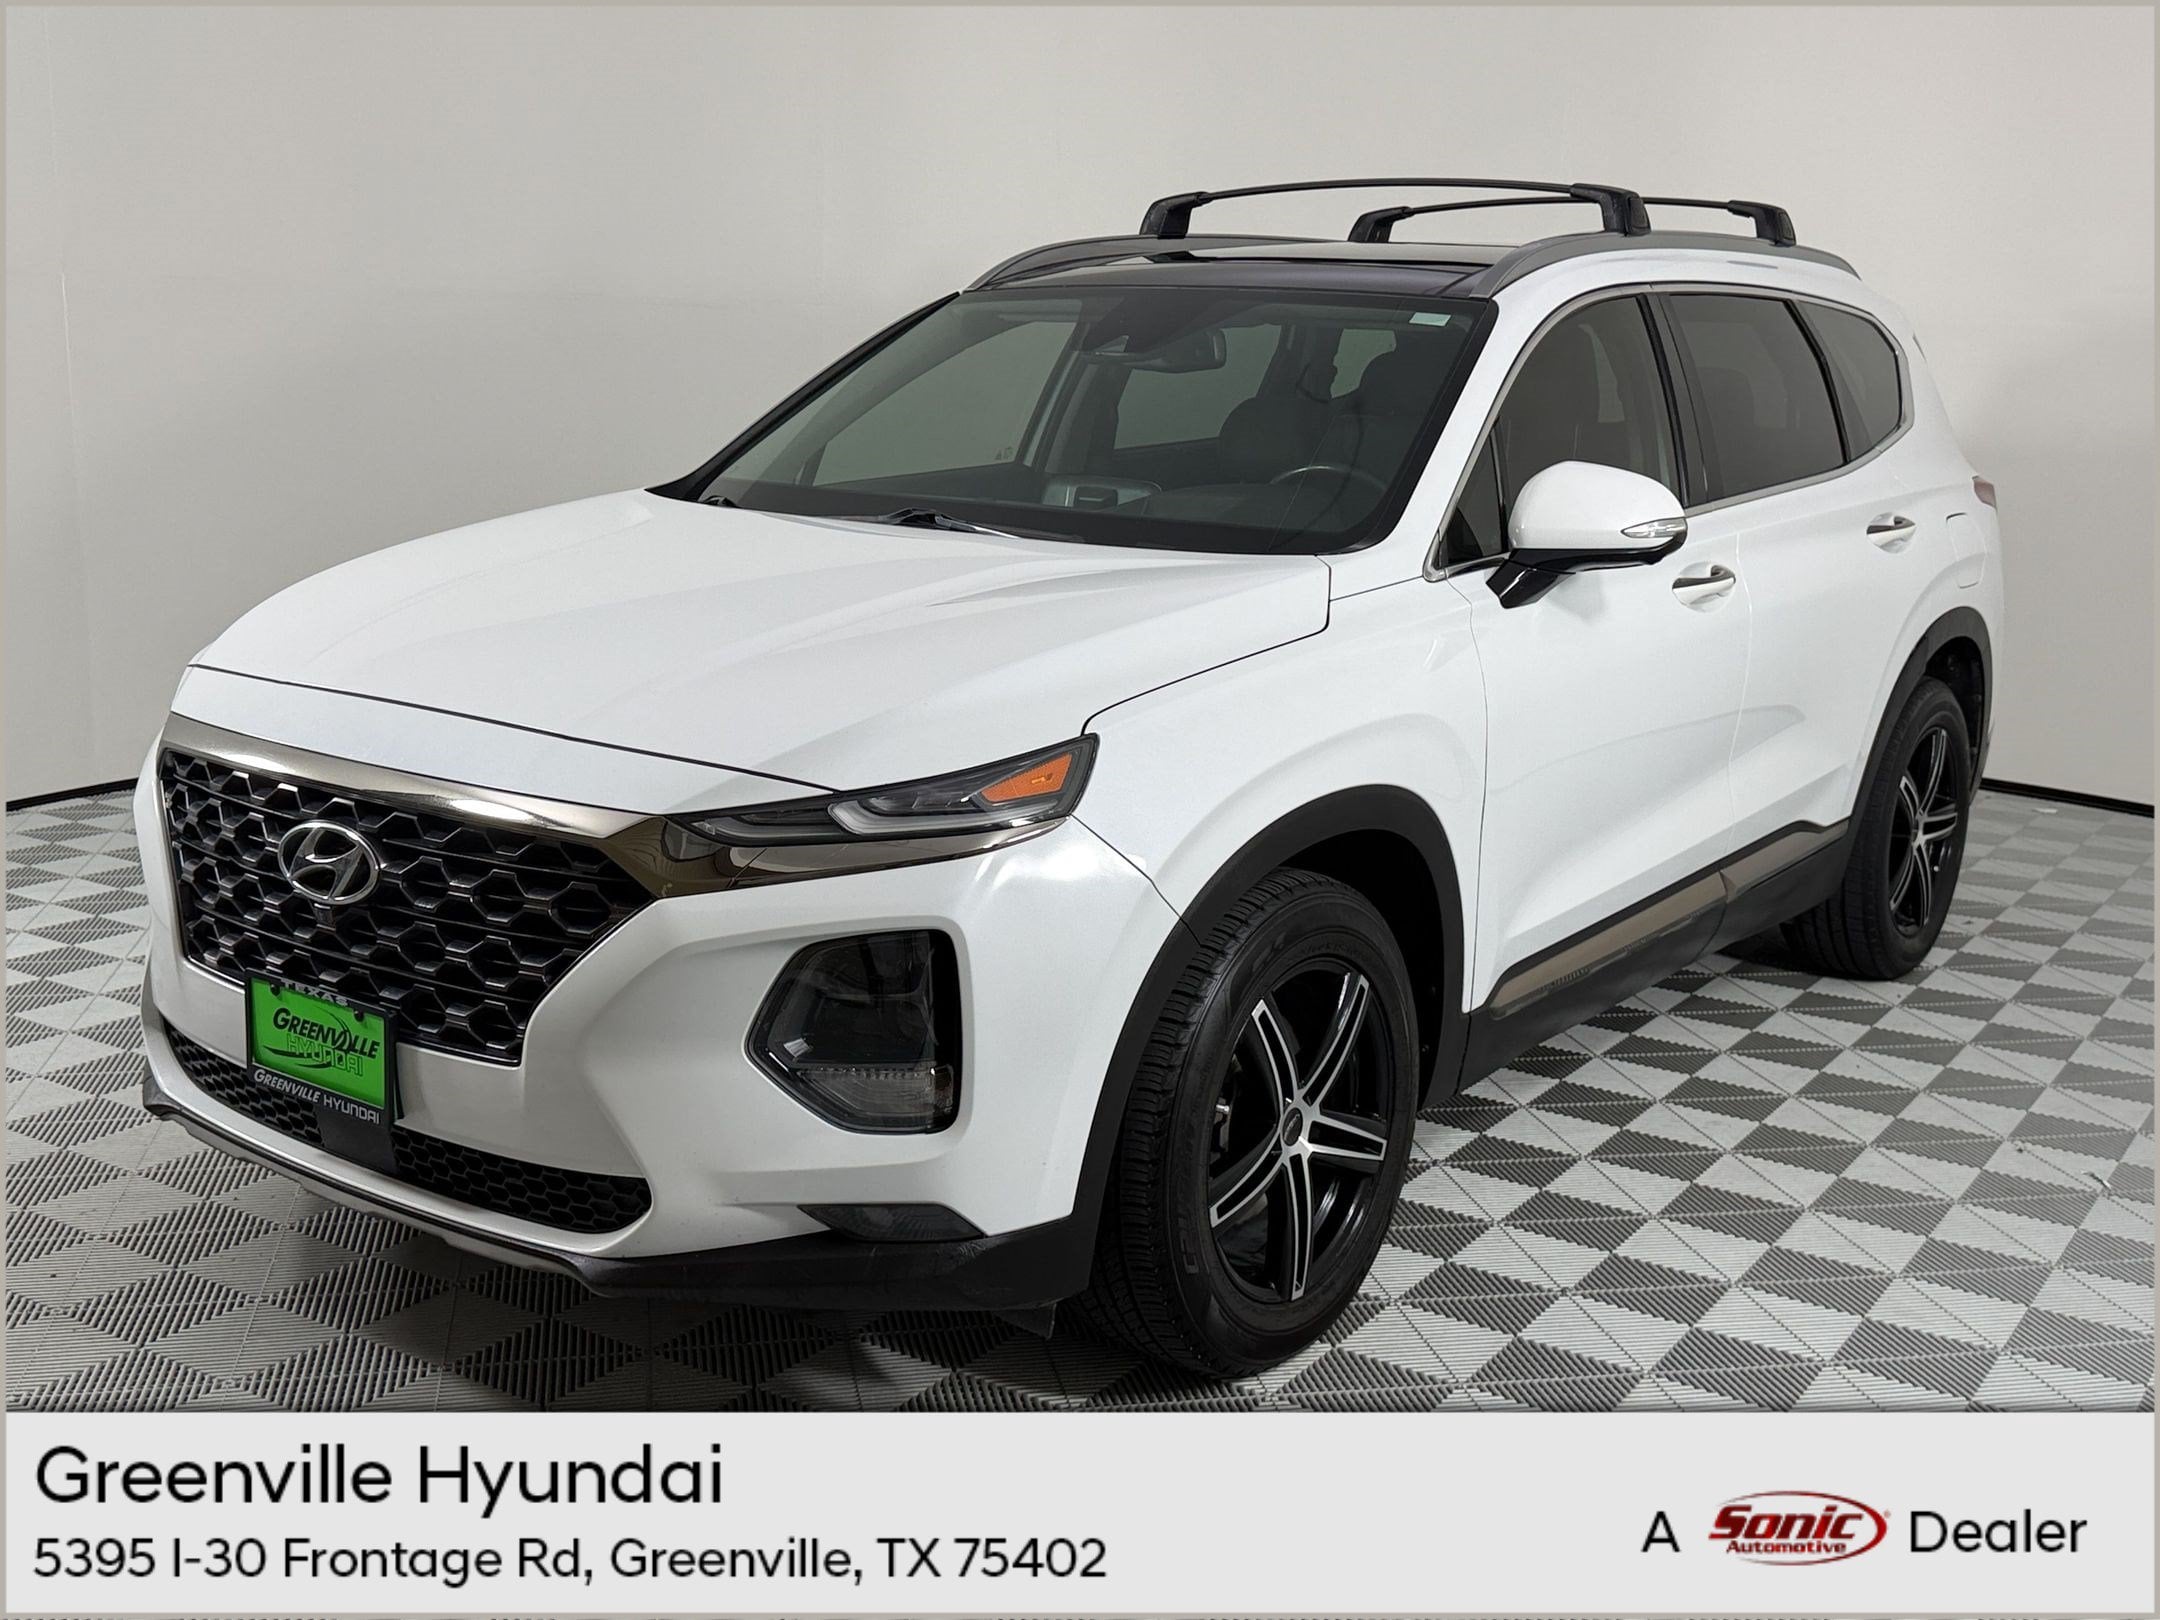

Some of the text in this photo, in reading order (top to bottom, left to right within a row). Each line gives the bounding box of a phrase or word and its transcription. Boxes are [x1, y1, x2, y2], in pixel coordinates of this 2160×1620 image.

[280, 978, 349, 1007] TEXAS
[273, 1007, 380, 1060] GREENVILLE
[286, 1033, 364, 1077] HYUNDAI
[253, 1069, 381, 1125] GREENVILLE HYUNDAI
